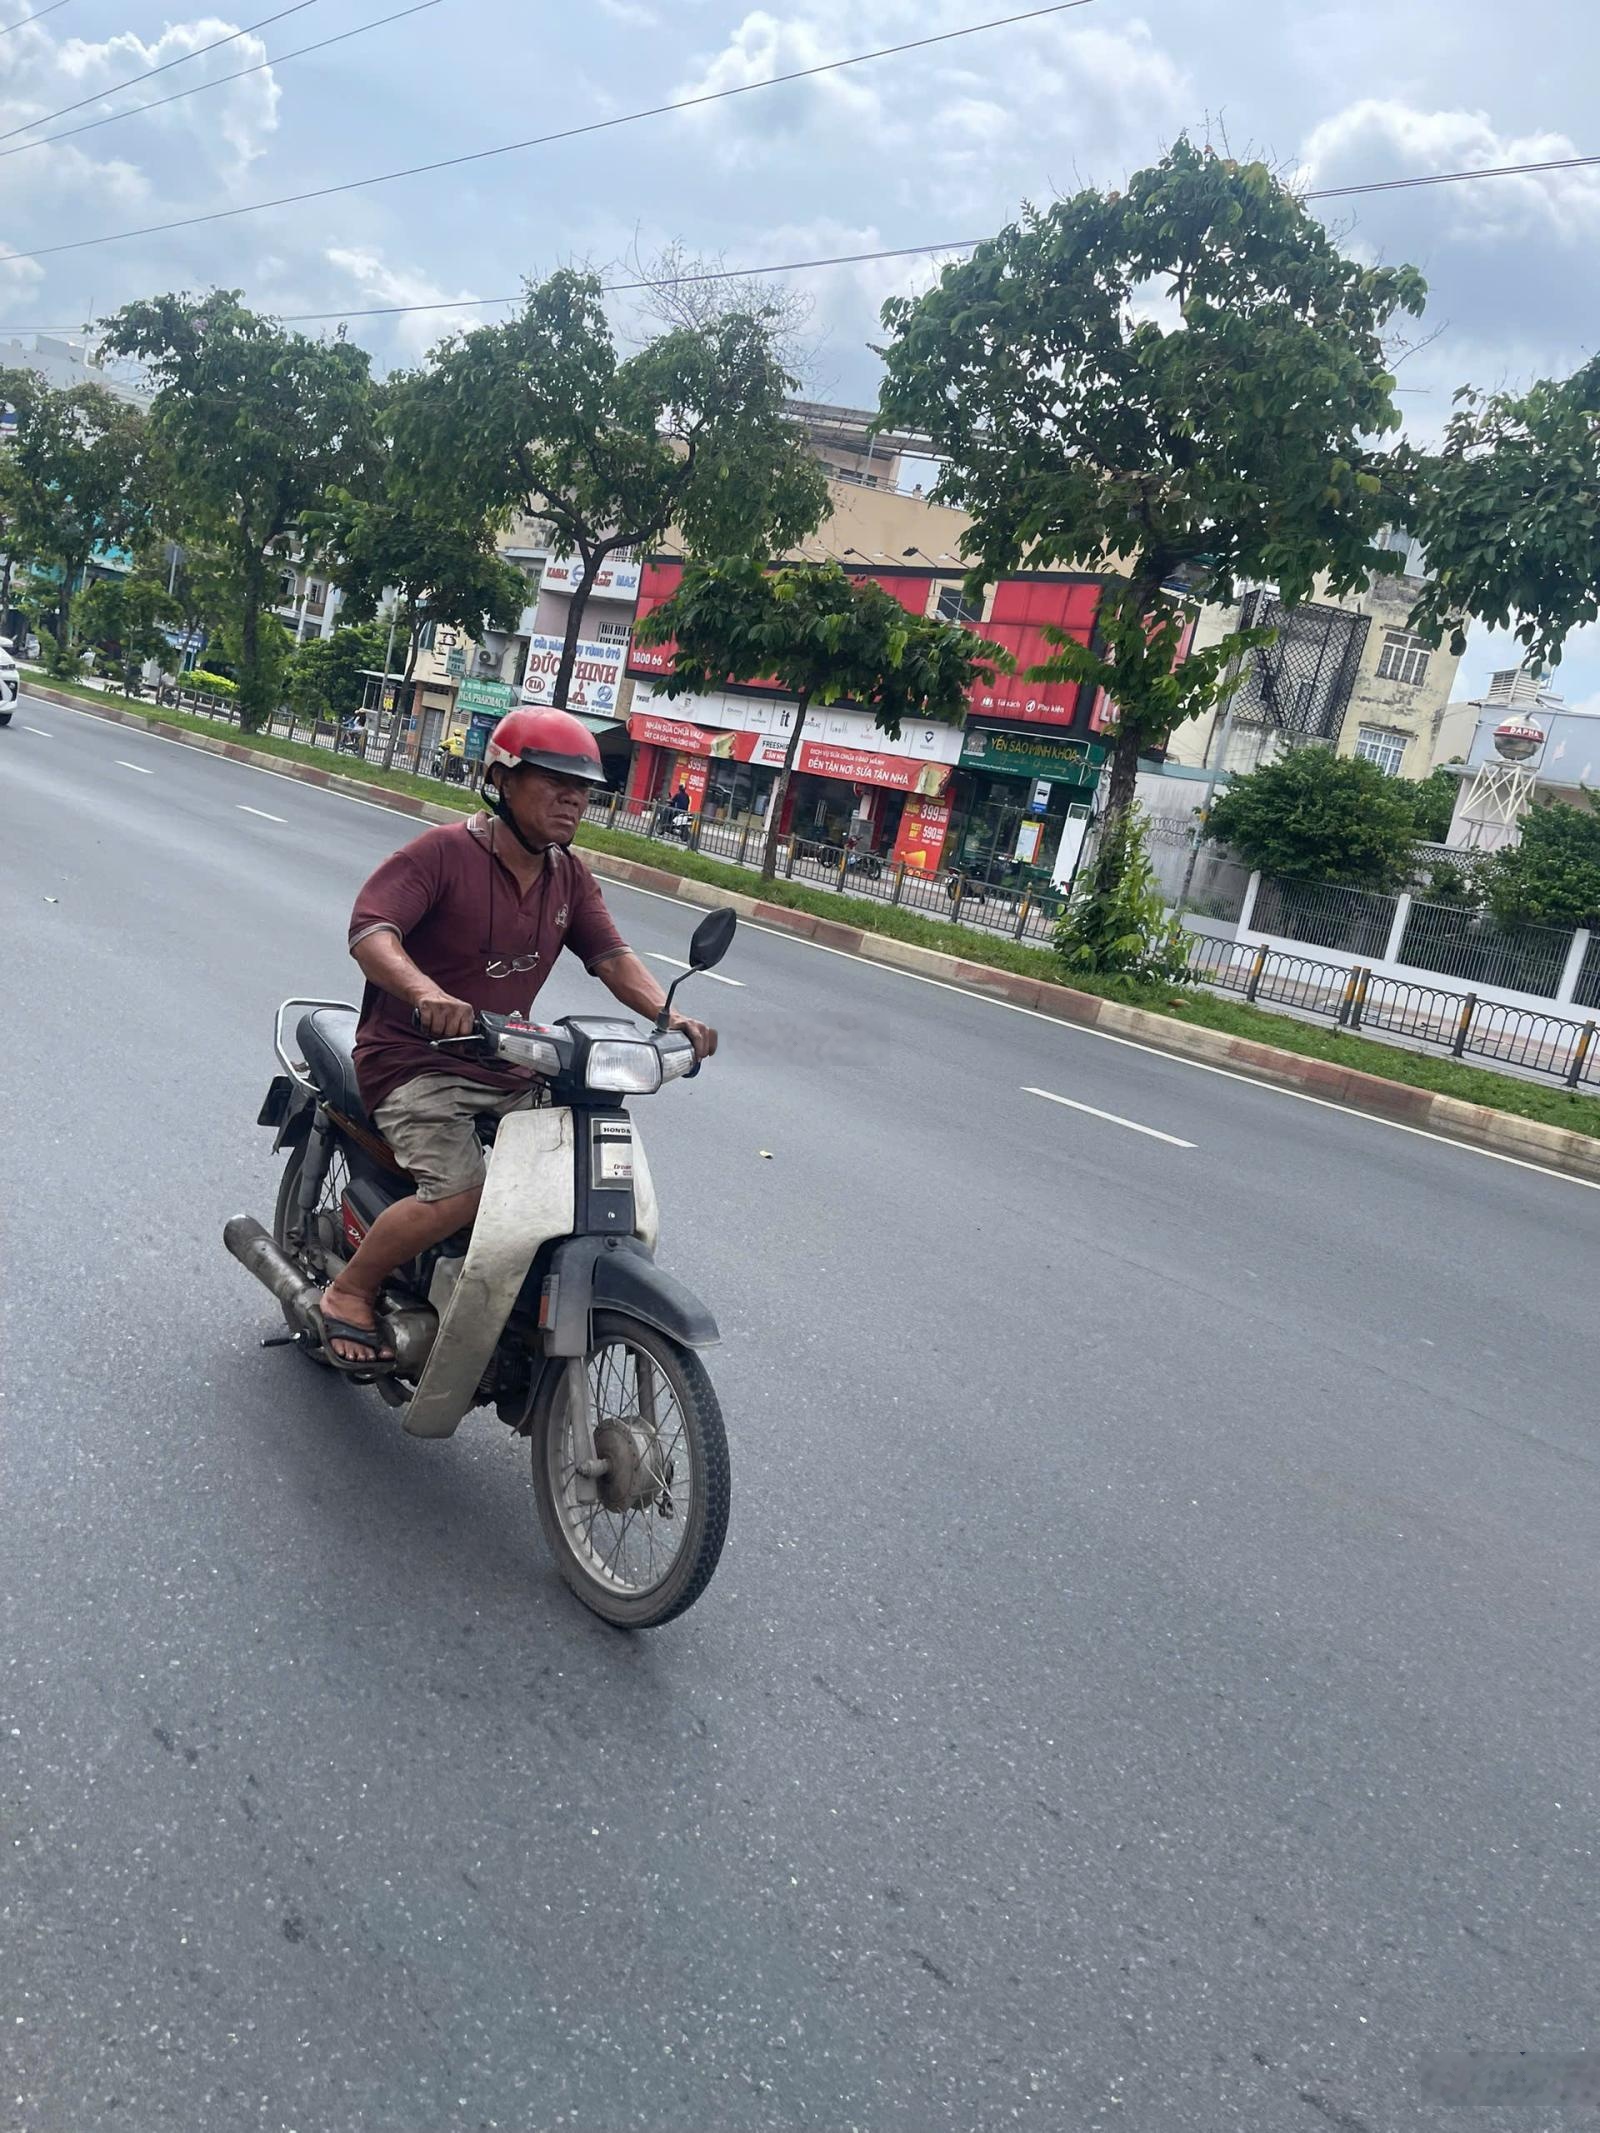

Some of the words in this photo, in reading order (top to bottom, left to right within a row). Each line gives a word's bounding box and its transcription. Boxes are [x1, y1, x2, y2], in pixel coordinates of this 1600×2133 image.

[616, 575, 637, 588] MAZ
[534, 636, 547, 649] CỬA
[585, 644, 604, 658] TÙNG
[632, 652, 650, 664] 1800
[652, 654, 663, 666] 66
[529, 651, 560, 676] ĐỨC
[575, 660, 618, 686] HỊNH
[528, 680, 542, 690] KIA
[780, 710, 790, 728] it
[690, 727, 704, 740] VALI
[991, 735, 1009, 750] YẾN
[1030, 744, 1052, 758] MINH
[1052, 747, 1078, 761] KHOA
[808, 757, 825, 770] ĐẾN
[825, 762, 841, 774] TẬN
[856, 764, 872, 778] SỬA
[873, 770, 890, 782] TẬN
[890, 772, 910, 785] NHÀ
[920, 804, 940, 822] 399
[922, 825, 936, 840] 590
